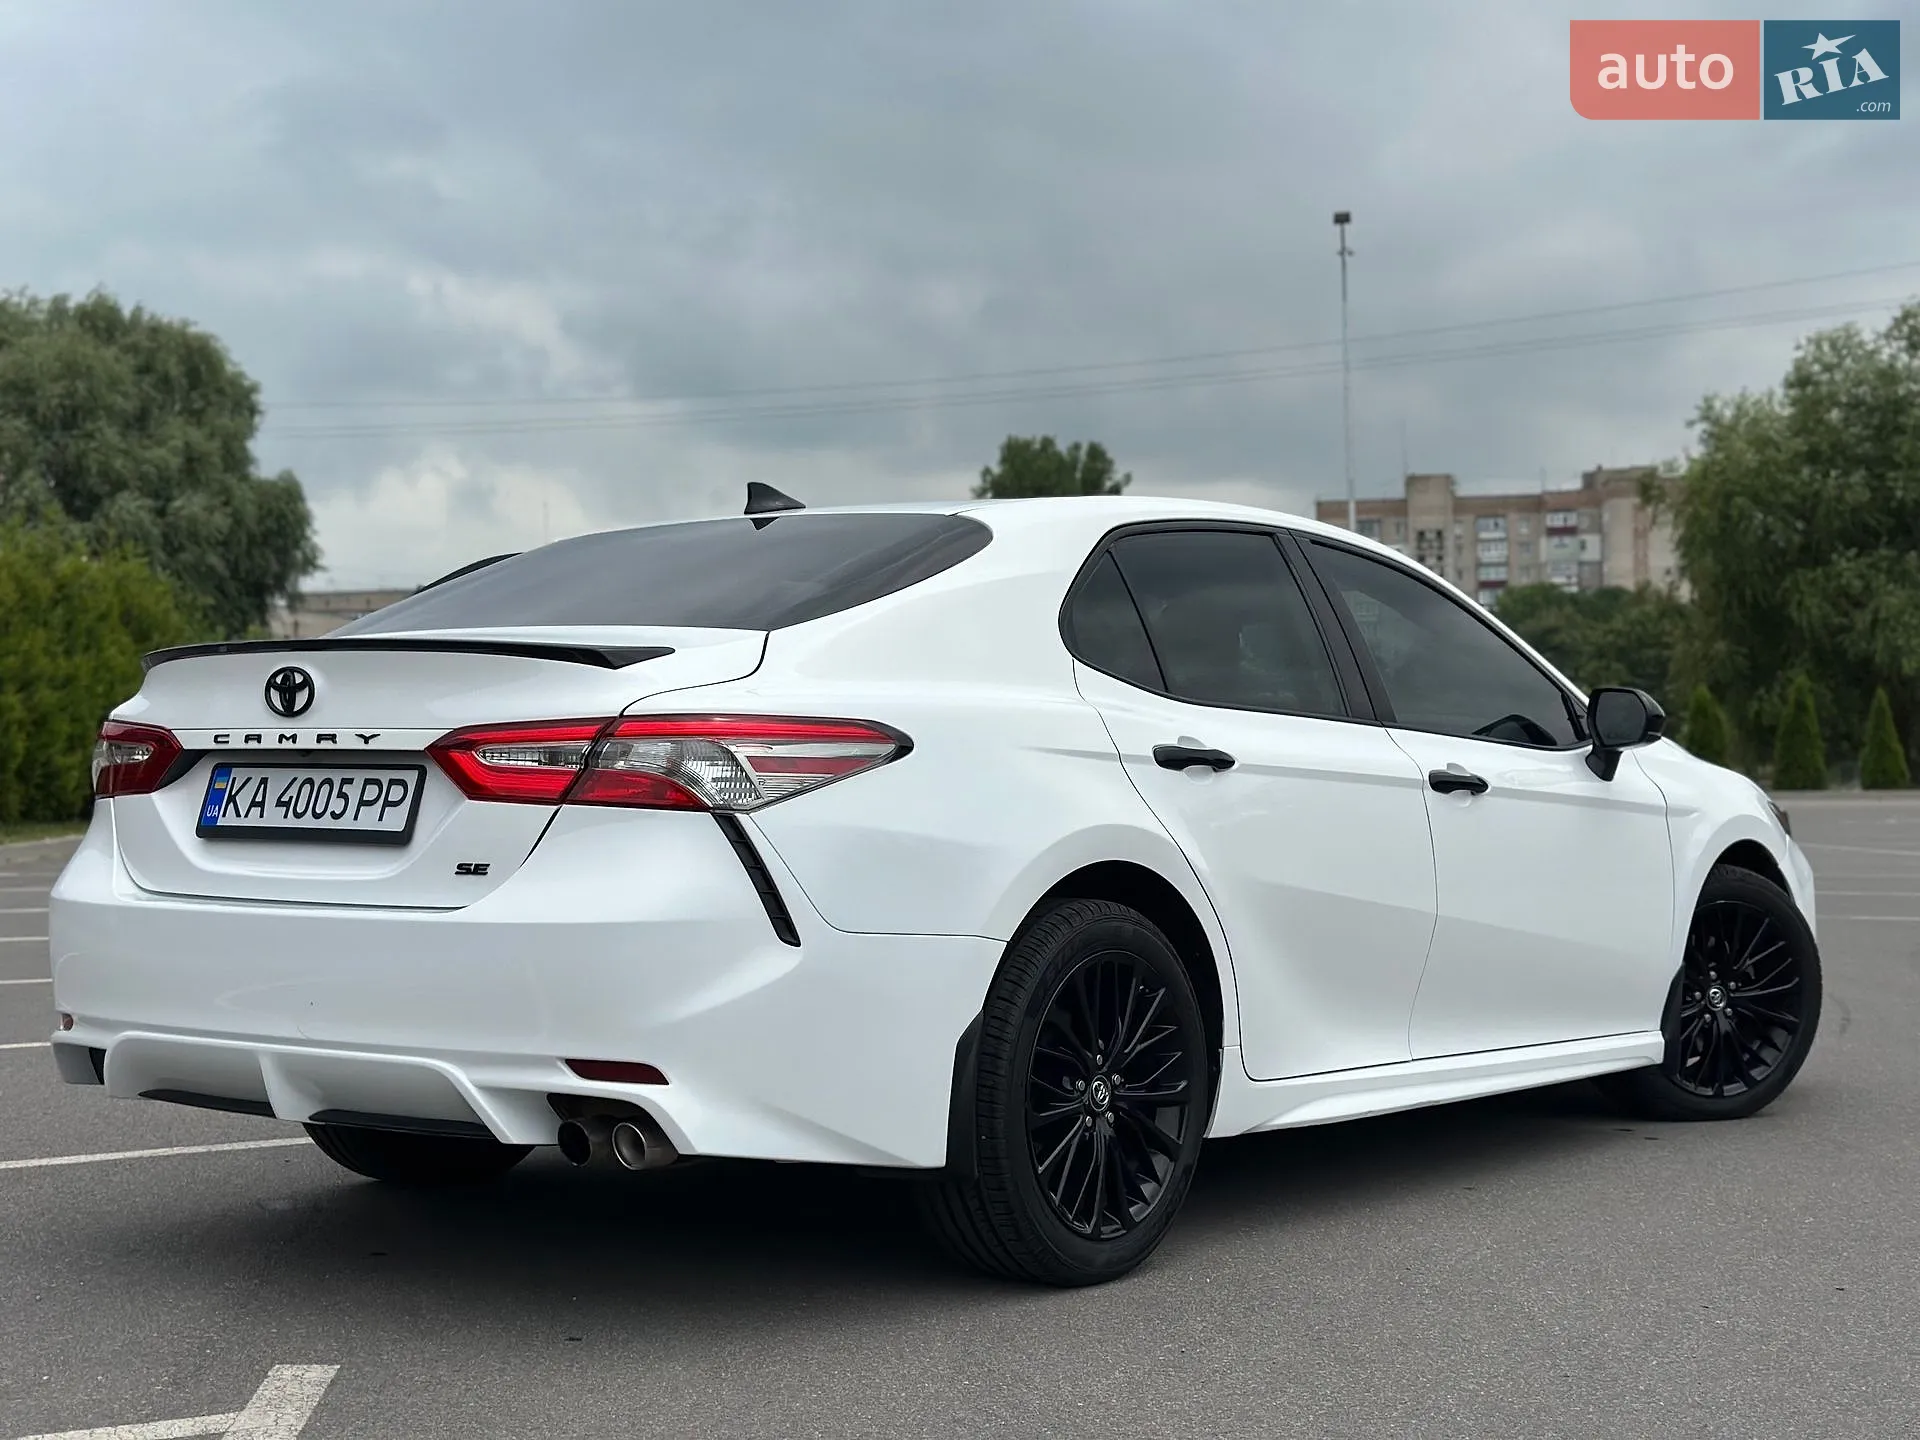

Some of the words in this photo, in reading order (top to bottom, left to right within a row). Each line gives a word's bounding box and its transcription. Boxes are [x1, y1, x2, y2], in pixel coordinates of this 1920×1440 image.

[213, 733, 382, 745] CAMRY
[206, 804, 219, 818] UA
[222, 776, 269, 819] KA
[275, 776, 355, 820] 4005
[353, 777, 409, 822] PP
[454, 862, 491, 876] SE
